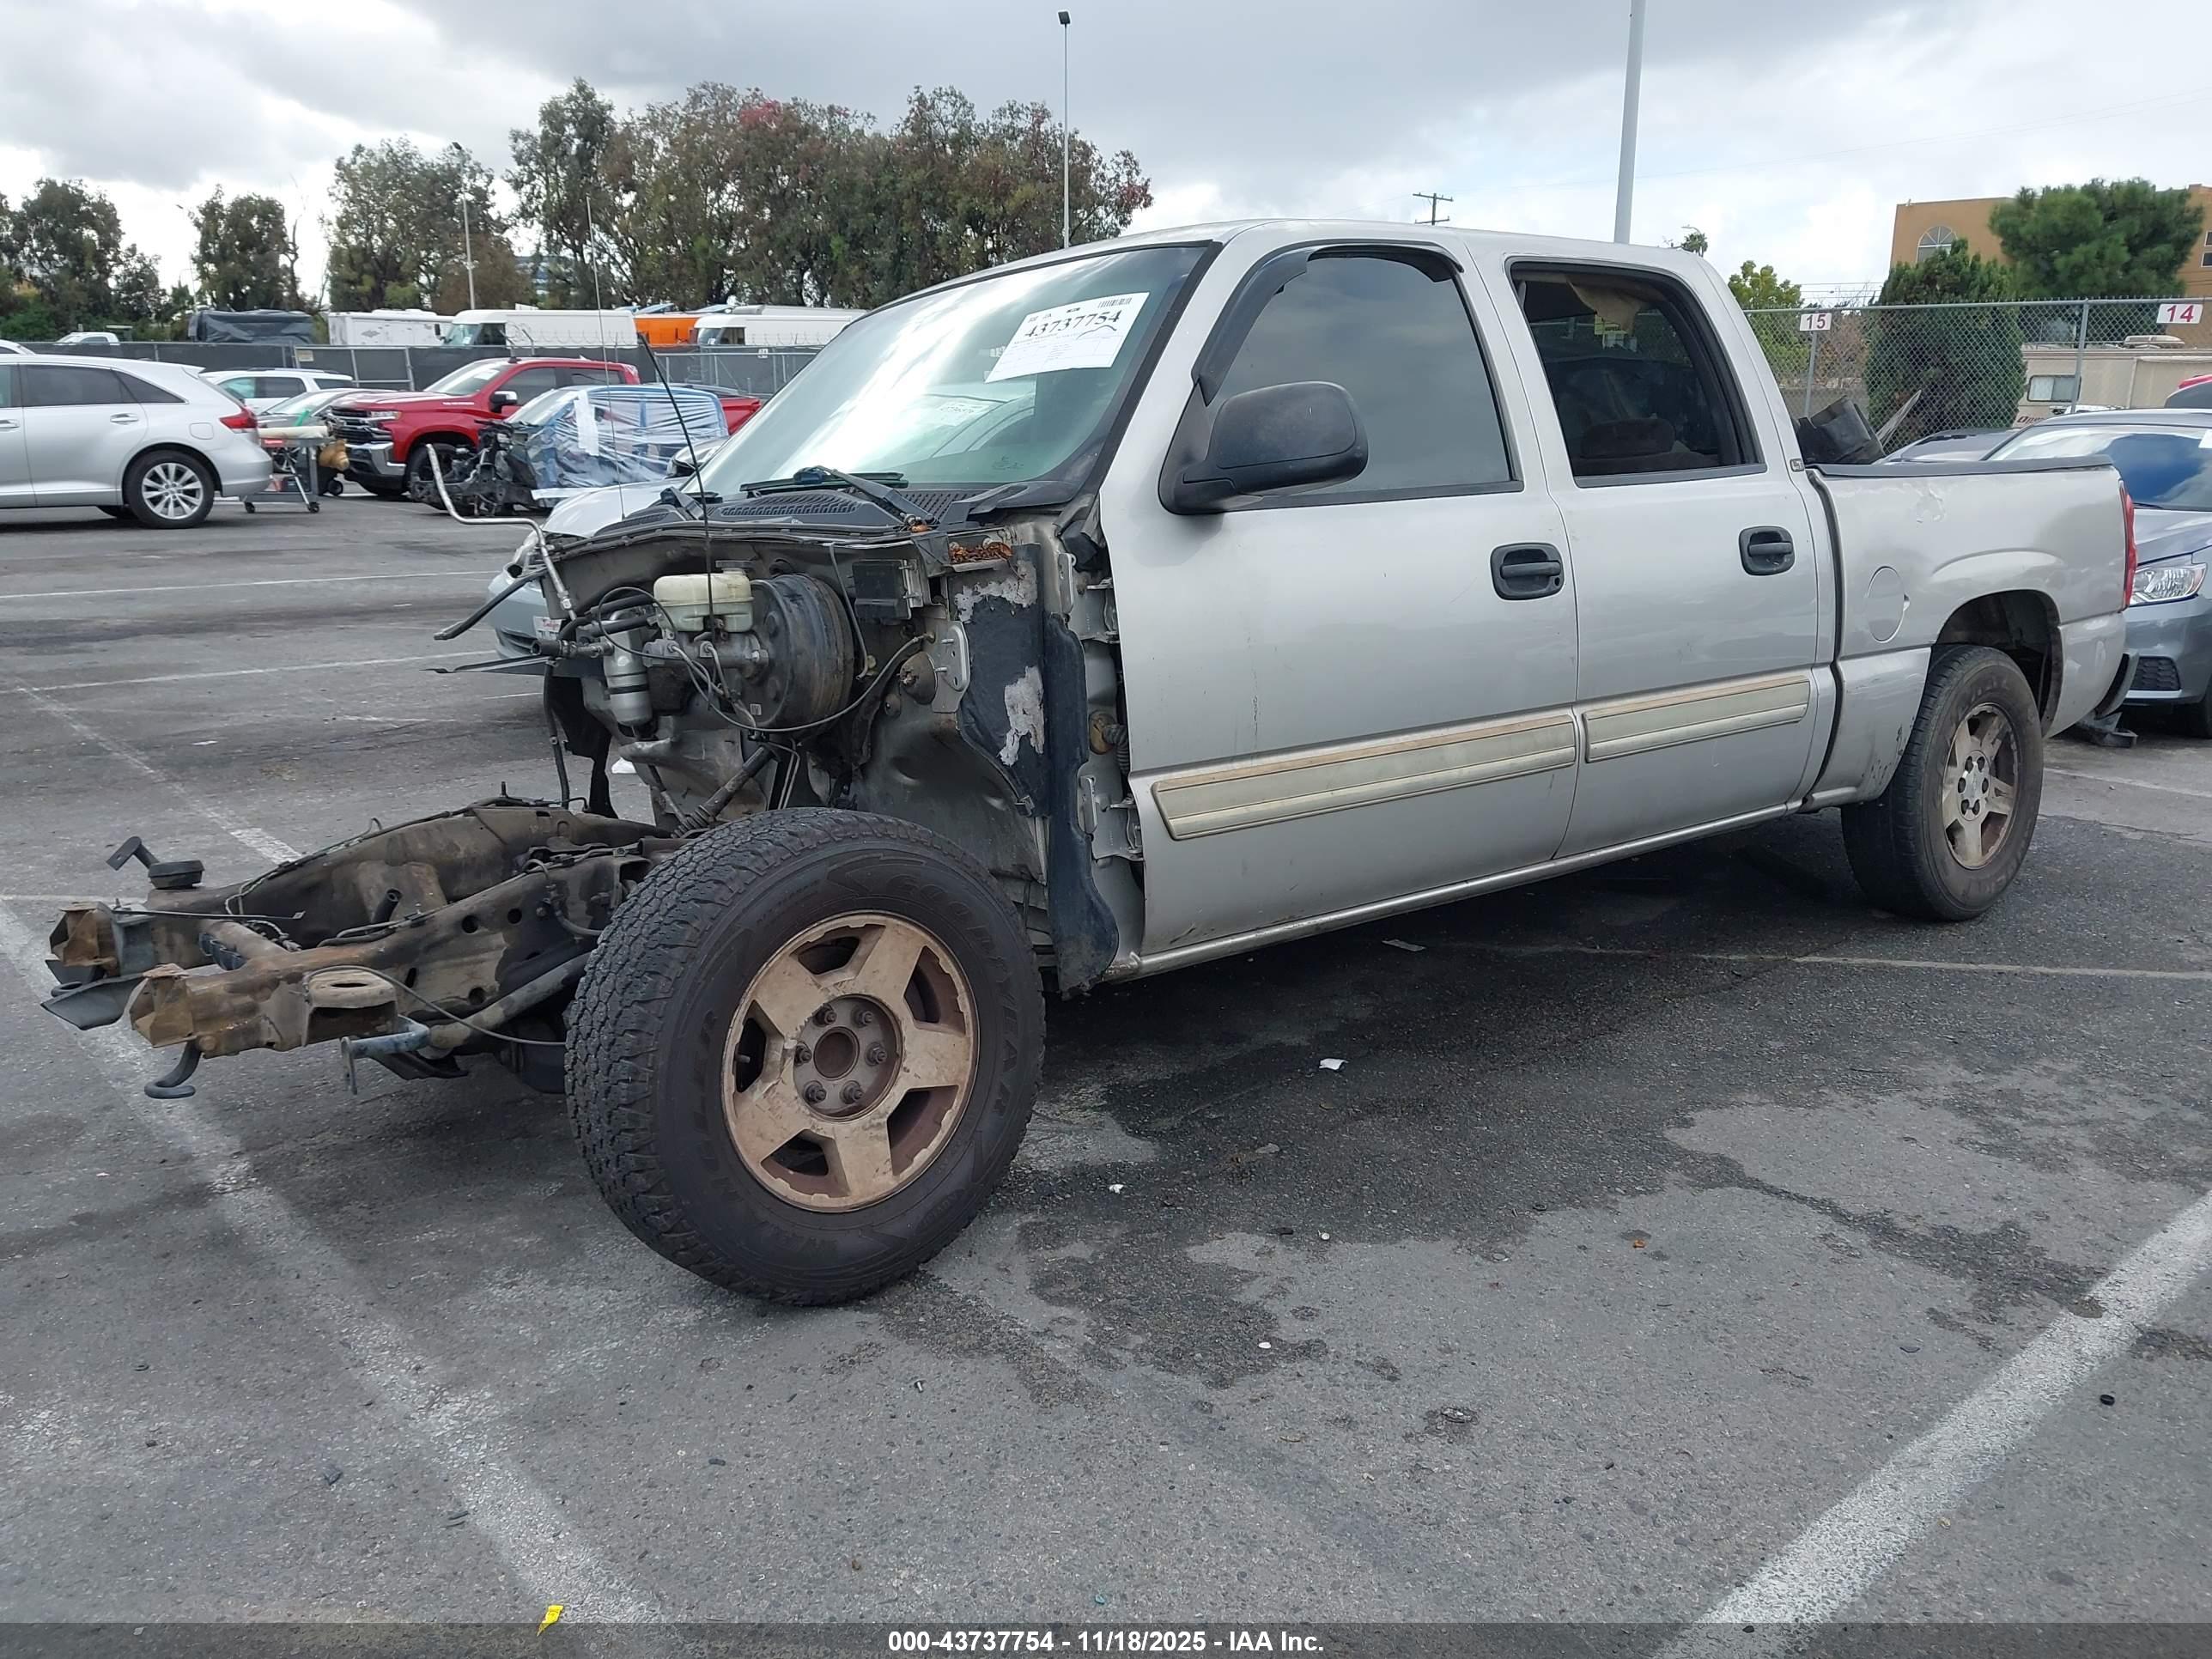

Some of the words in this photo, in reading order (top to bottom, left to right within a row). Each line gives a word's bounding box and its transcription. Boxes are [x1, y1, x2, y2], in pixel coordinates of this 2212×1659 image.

[1024, 309, 1122, 337] 43737754
[1806, 313, 1826, 330] 15
[2166, 305, 2195, 323] 14
